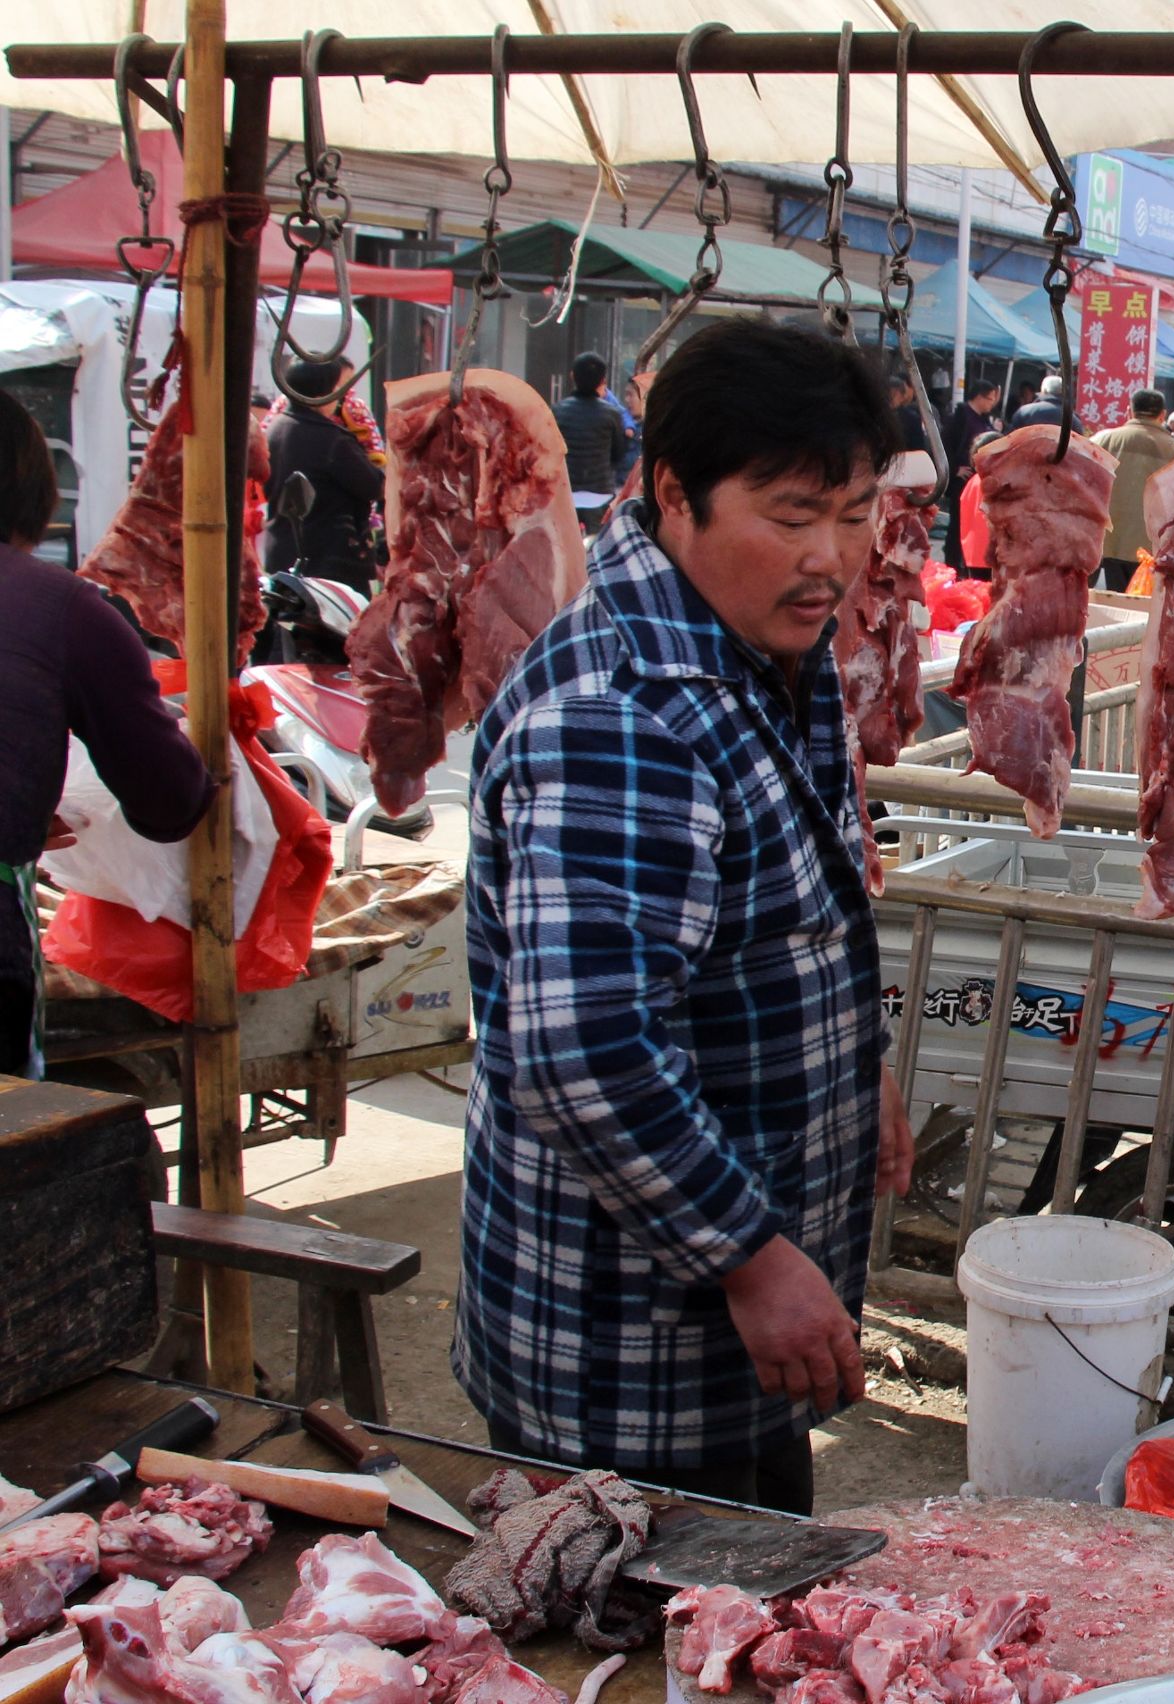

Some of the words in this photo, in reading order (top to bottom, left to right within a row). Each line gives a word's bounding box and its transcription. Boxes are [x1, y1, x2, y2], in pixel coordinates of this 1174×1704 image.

[1087, 290, 1148, 318] 早点
[881, 985, 960, 1023] 千之行
